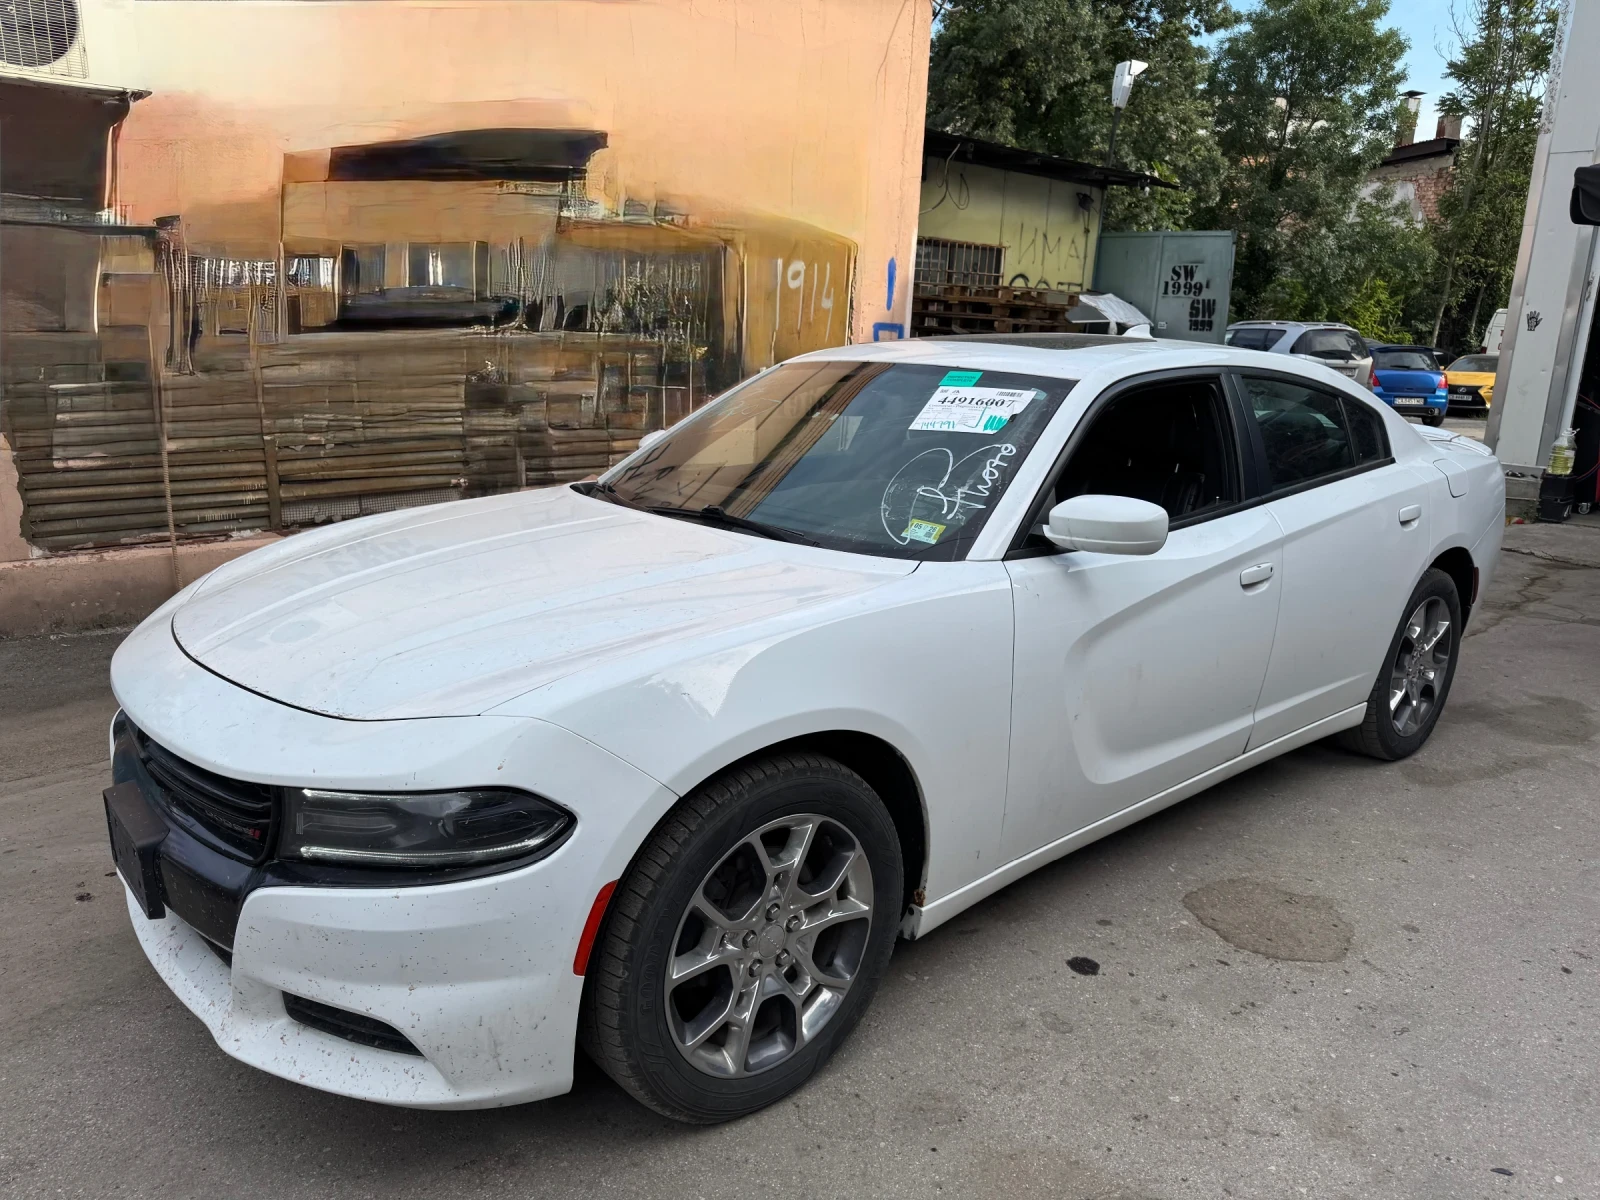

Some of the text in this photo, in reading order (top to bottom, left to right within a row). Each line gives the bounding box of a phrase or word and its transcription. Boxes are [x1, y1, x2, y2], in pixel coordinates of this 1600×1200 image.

[1170, 264, 1199, 282] SW
[1162, 281, 1204, 297] 1999
[1188, 299, 1217, 319] SW
[1188, 319, 1214, 332] 1999
[913, 522, 938, 533] 05 26
